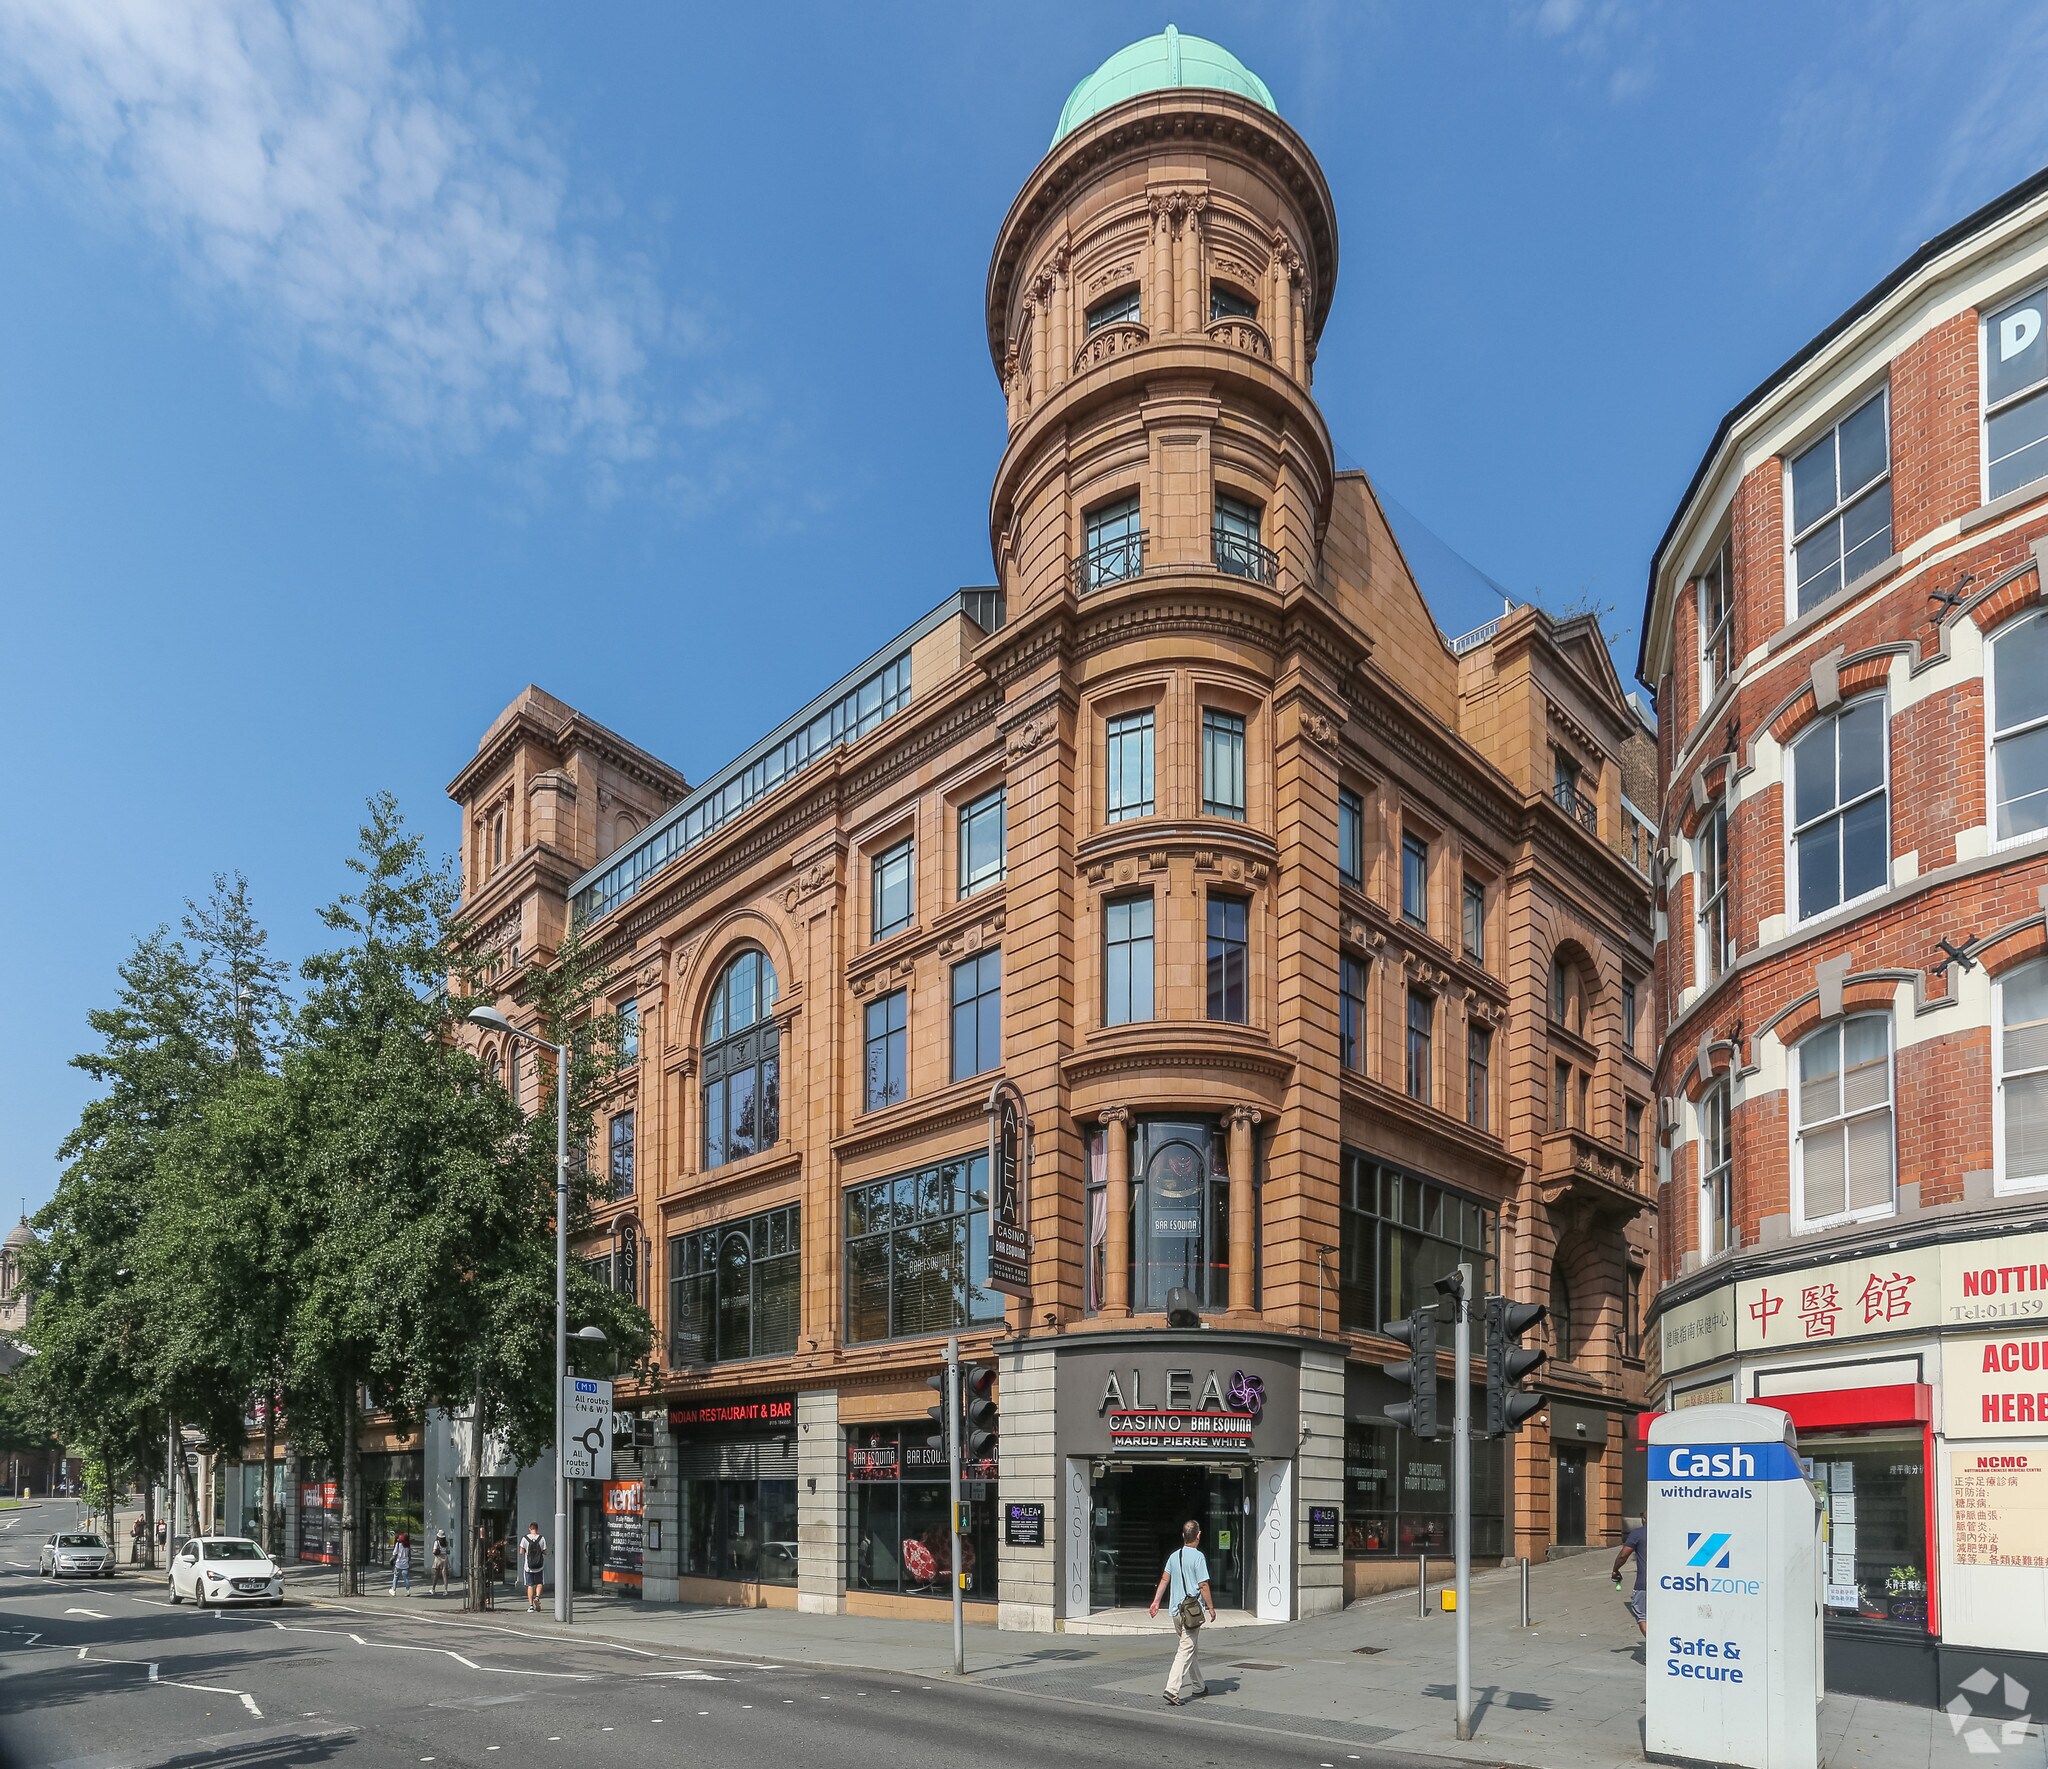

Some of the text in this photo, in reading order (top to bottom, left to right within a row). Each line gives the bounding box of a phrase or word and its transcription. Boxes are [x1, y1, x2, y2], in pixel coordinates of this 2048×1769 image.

[1003, 1106, 1016, 1219] ALEA
[1155, 1219, 1197, 1231] BAR ESQUINA
[998, 1225, 1025, 1243] CASINO
[995, 1240, 1026, 1260] BAR ESQUINA
[910, 1260, 921, 1273] BAR
[994, 1262, 1027, 1278] INSTANT FREE
[994, 1270, 1027, 1283] MEMBERSHIP
[1749, 1272, 1916, 1339] 中醫館
[576, 1382, 596, 1393] (M1)
[1098, 1369, 1228, 1412] ALEA
[587, 1397, 609, 1406] routes
[670, 1402, 792, 1424] INDIAN RESTAURANT & BAR
[1109, 1416, 1252, 1433] CASINO BAR ESQUINA
[1115, 1436, 1246, 1447] MARCO PIERRE WHITE
[573, 1450, 583, 1458] All
[853, 1450, 895, 1466] BAR ESQUINA
[906, 1450, 921, 1464] BAR
[1977, 1456, 2028, 1468] NCMC
[566, 1459, 589, 1467] routes
[1668, 1447, 1755, 1478] Cash
[570, 1467, 586, 1477] (S)
[609, 1484, 641, 1511] rent!
[1660, 1485, 1753, 1499] withdrawals
[1020, 1507, 1038, 1517] ALEA
[1072, 1472, 1083, 1605] CASINO
[1268, 1473, 1282, 1607] CASINO
[1660, 1572, 1760, 1595] cashzone
[1669, 1636, 1741, 1660] Safe &
[1667, 1659, 1743, 1683] Secure
